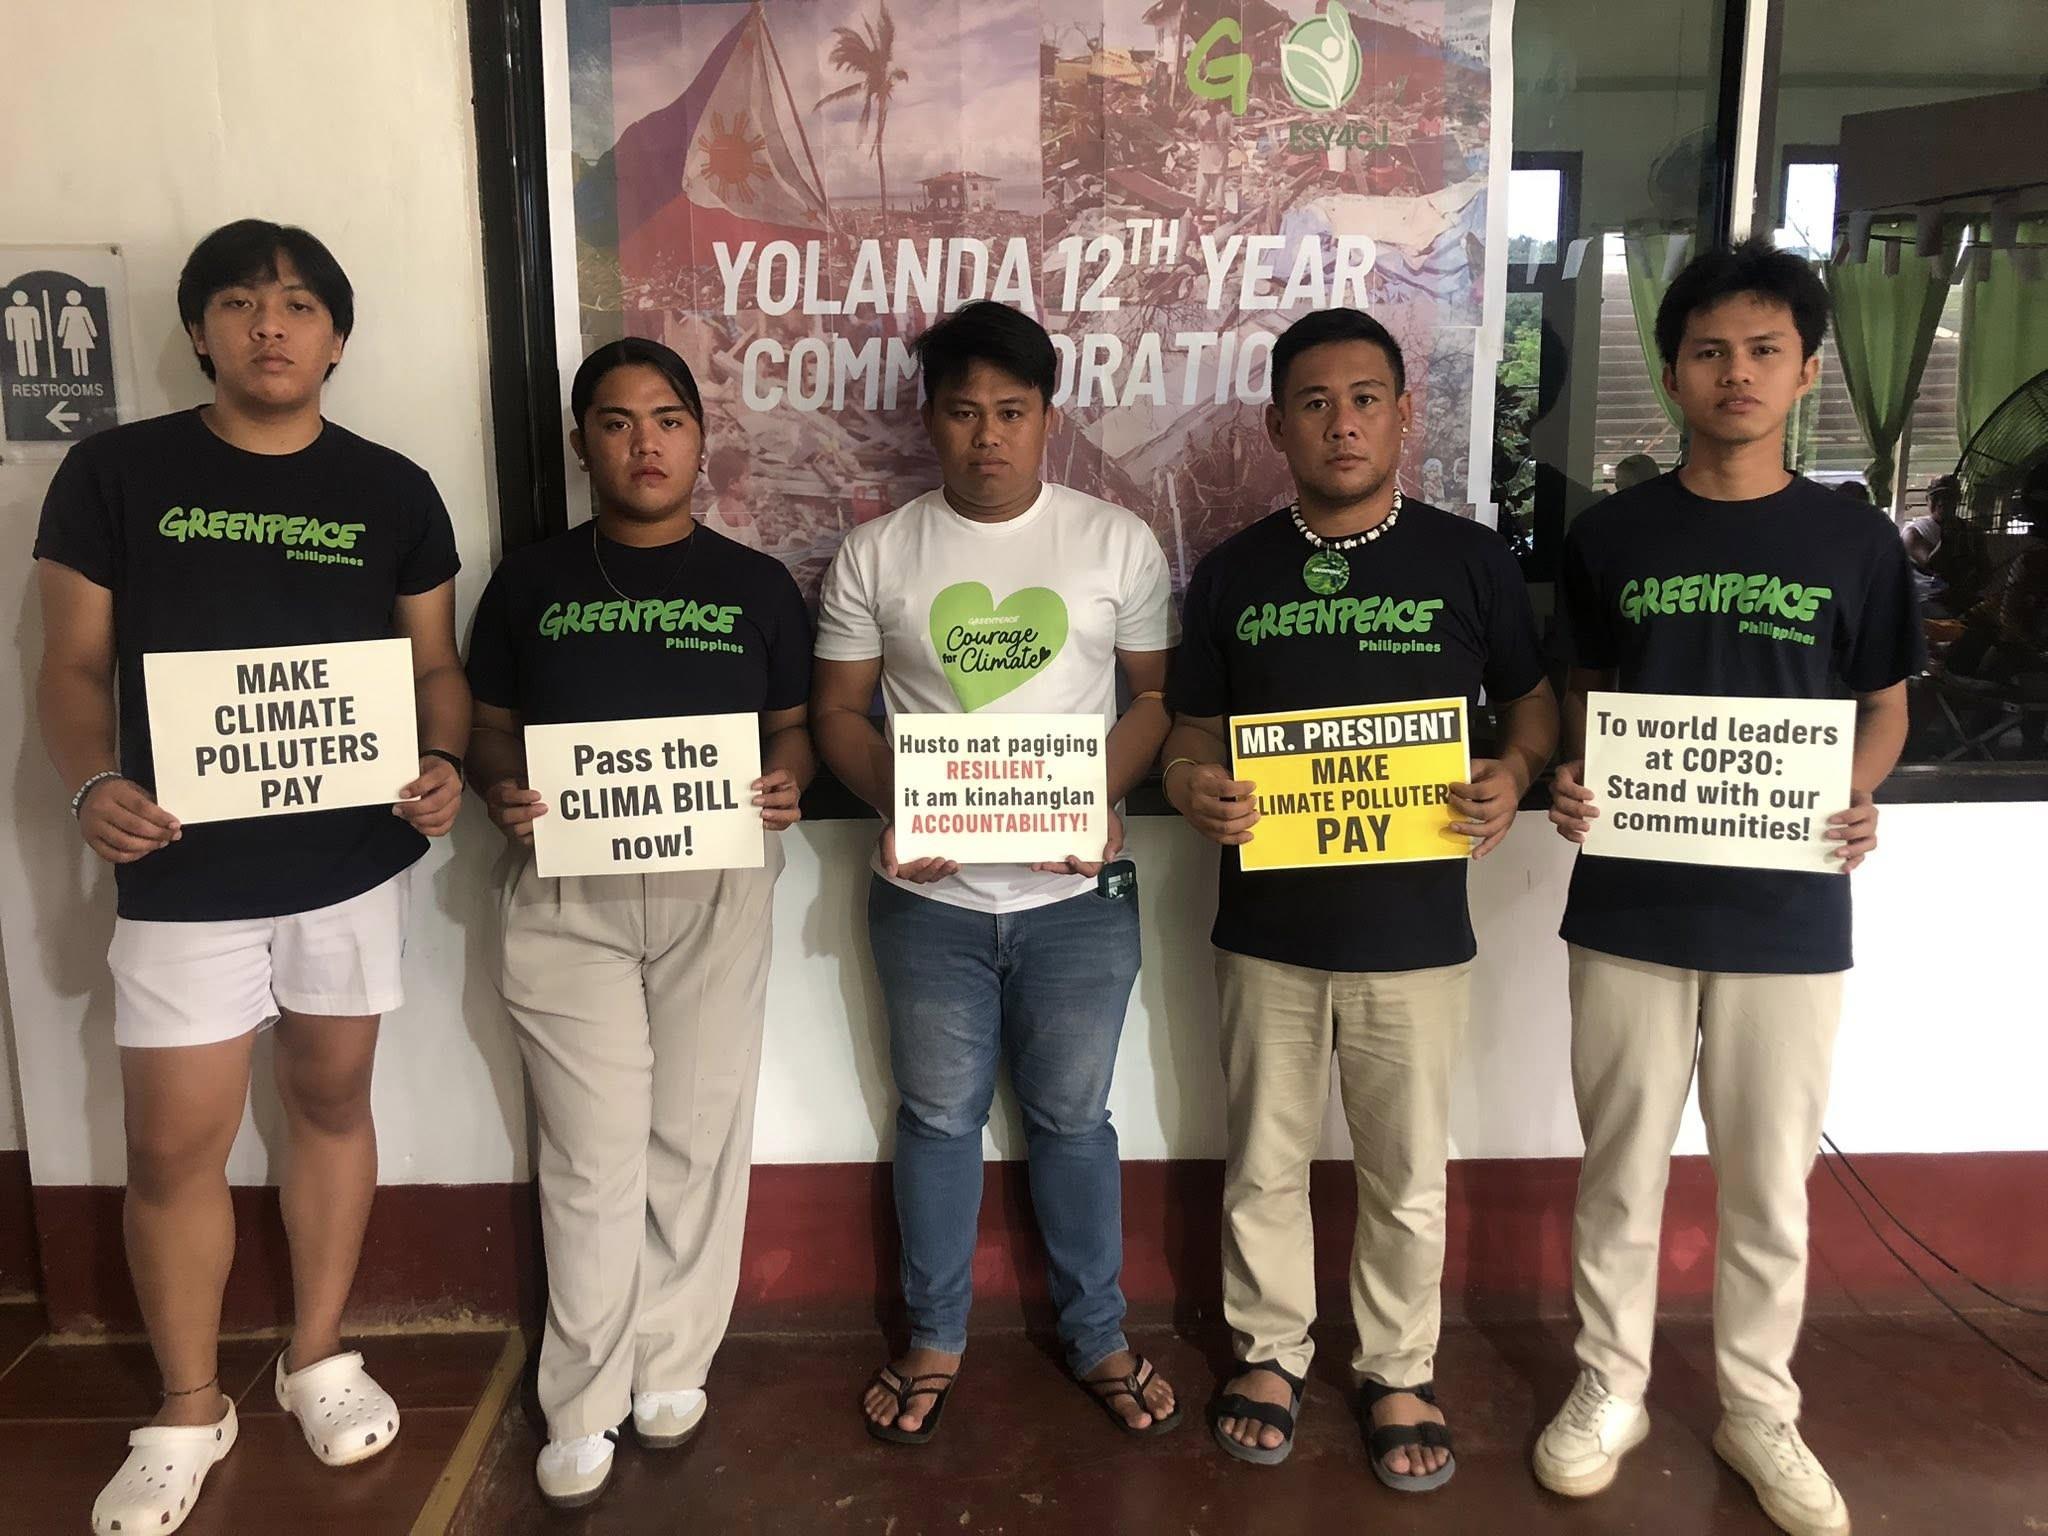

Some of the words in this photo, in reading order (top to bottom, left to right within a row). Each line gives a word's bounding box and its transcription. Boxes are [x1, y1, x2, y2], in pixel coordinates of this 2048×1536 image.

[712, 237, 1036, 315] YOLANDA
[1058, 219, 1178, 312] 12TH
[1200, 234, 1376, 310] YEAR
[12, 383, 104, 397] RESTROOMS
[158, 506, 366, 549] GREENPEACE
[286, 550, 364, 567] Philippines
[1620, 573, 1832, 624] GREENPEACE
[539, 599, 743, 641] GREENPEACE
[1236, 596, 1444, 646] GREENPEACE
[1738, 620, 1815, 645] Philippines
[666, 637, 744, 654] Philippines
[946, 625, 1039, 658] Courage
[1359, 639, 1441, 654] Philippines
[236, 658, 329, 695] MAKE
[942, 653, 957, 664] for
[960, 646, 1042, 673] Climate
[214, 695, 356, 735] CLIMATE
[1597, 711, 1627, 736] To
[1637, 715, 1718, 741] world
[1729, 717, 1838, 745] leaders
[899, 734, 959, 753] Husto
[967, 736, 1000, 753] nat
[1008, 734, 1098, 757] pagiging
[1241, 725, 1295, 754] MR.
[1303, 711, 1455, 750] PRESIDENT
[195, 732, 379, 776] POLLUTERS
[573, 744, 652, 776] Pass
[661, 738, 718, 770] the
[946, 760, 1053, 782] RESILIENT,
[1311, 754, 1390, 785] MAKE
[1645, 748, 1673, 770] at
[1683, 747, 1784, 776] COP30:
[260, 774, 323, 809] PAY
[559, 784, 663, 821] CLIMA
[672, 779, 738, 813] BILL
[904, 787, 919, 807] it
[926, 791, 957, 807] am
[965, 787, 1095, 810] kinahanglan
[1253, 791, 1335, 816] LIMATE
[1342, 783, 1451, 811] POLLUTER
[1607, 775, 1686, 803] Stand
[1697, 780, 1759, 806] with
[1769, 788, 1820, 809] our
[911, 813, 1088, 834] ACCOUNTABILITY!
[1316, 814, 1391, 854] PAY
[1613, 811, 1810, 841] communities!
[611, 825, 693, 861] now!
